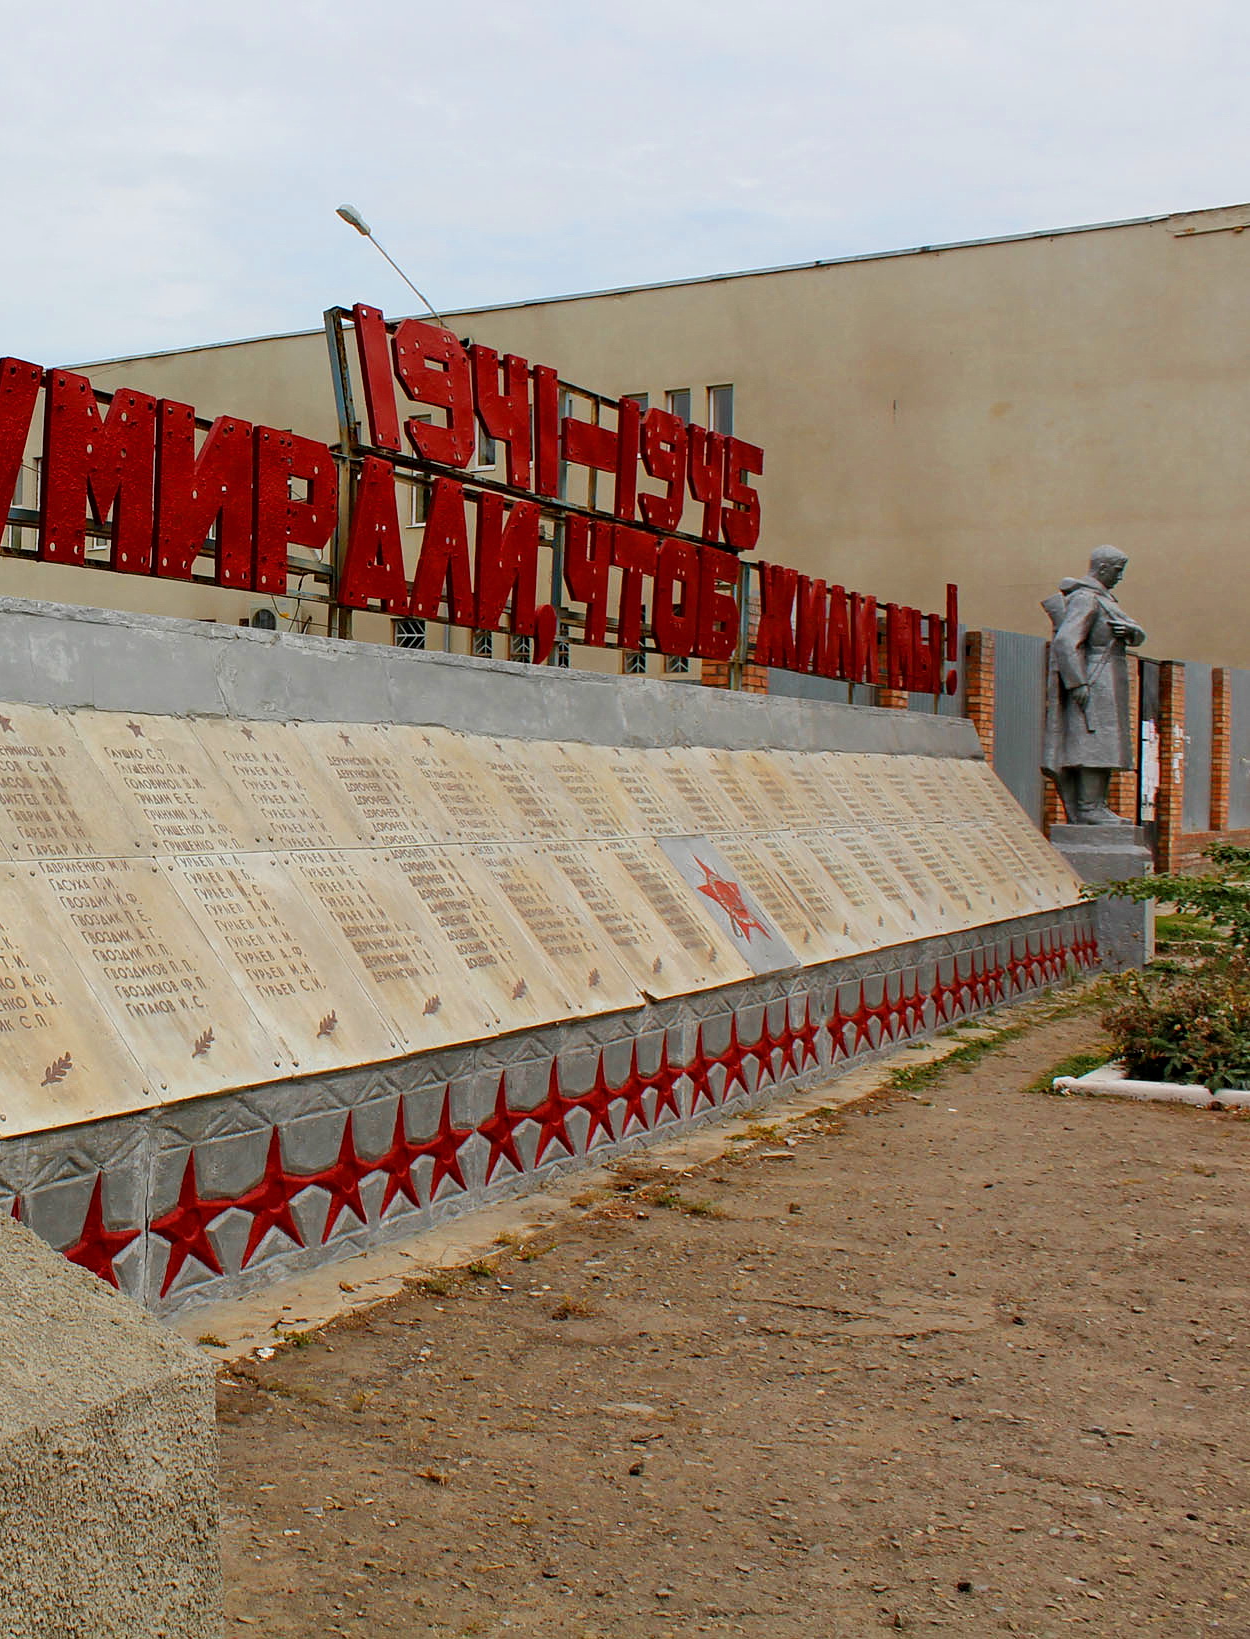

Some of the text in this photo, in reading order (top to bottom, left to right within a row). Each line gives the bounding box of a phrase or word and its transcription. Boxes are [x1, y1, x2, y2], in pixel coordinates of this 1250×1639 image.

[353, 303, 764, 550] 1941-1945
[564, 512, 739, 659] ЧТОБ
[754, 560, 877, 684] ЖИЛИ
